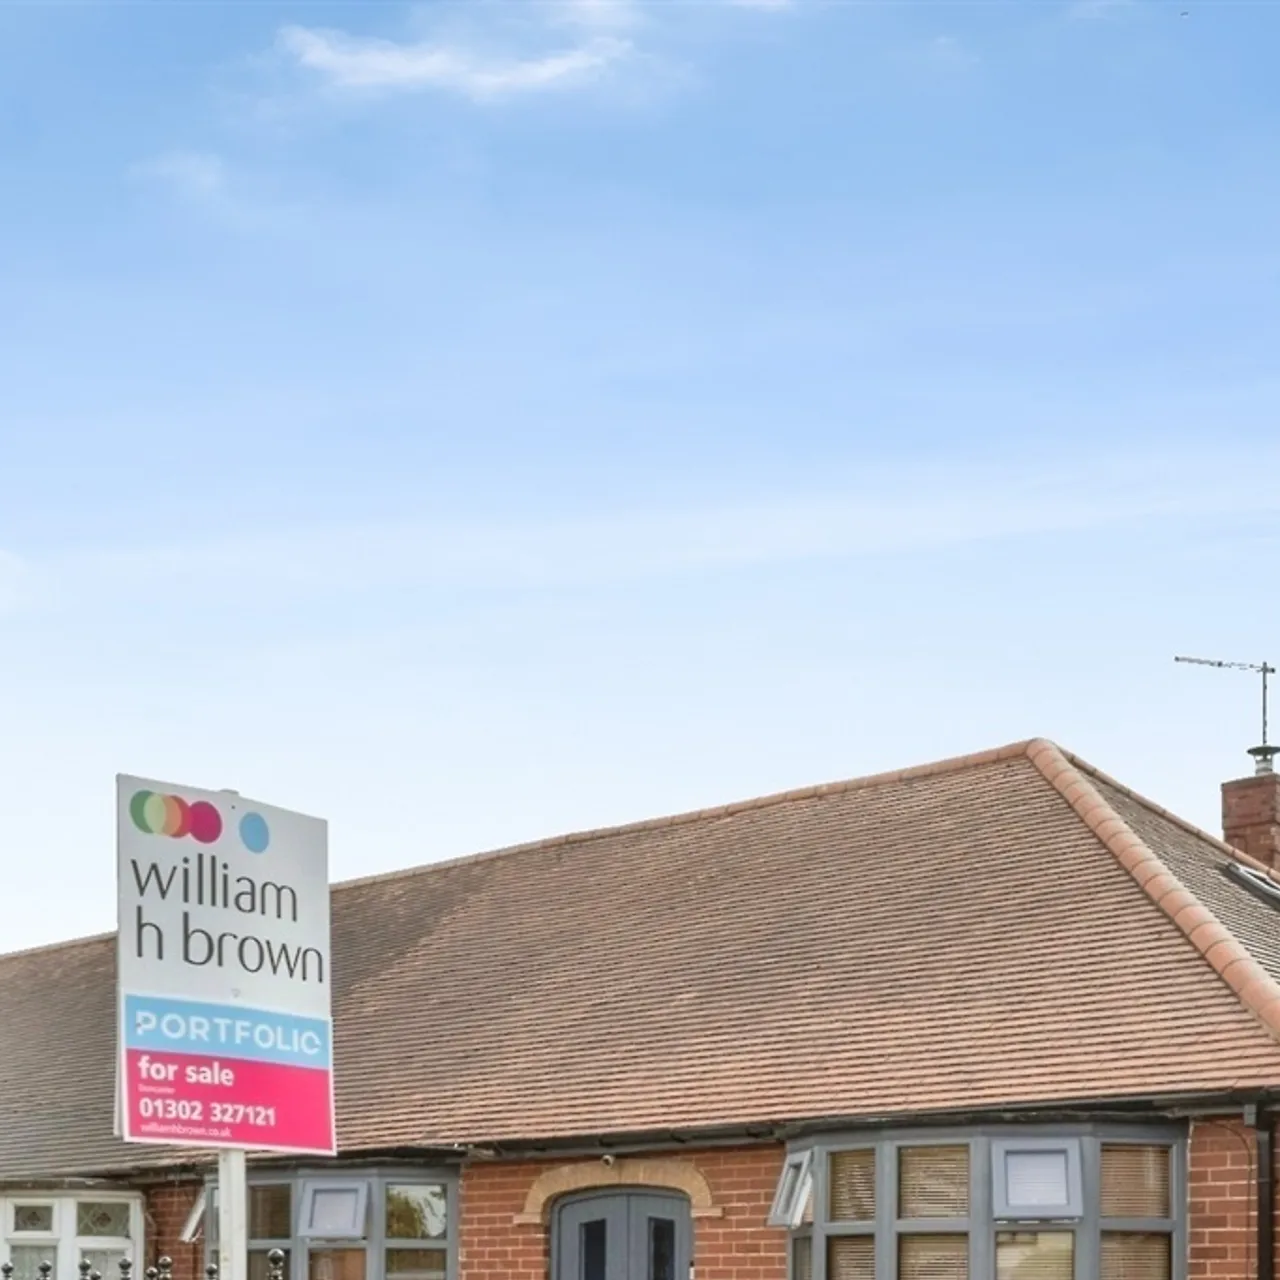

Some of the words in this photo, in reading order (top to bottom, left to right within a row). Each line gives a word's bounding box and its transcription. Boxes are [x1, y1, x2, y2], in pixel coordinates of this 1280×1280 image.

[131, 853, 297, 922] william
[136, 905, 164, 960] h
[182, 911, 323, 983] brown
[135, 1010, 322, 1056] PORTFOLIO
[138, 1055, 178, 1081] for
[185, 1061, 234, 1086] sale
[139, 1097, 203, 1121] 01302
[209, 1102, 276, 1127] 327121
[140, 1121, 233, 1138] williamhbrown.co.uk
